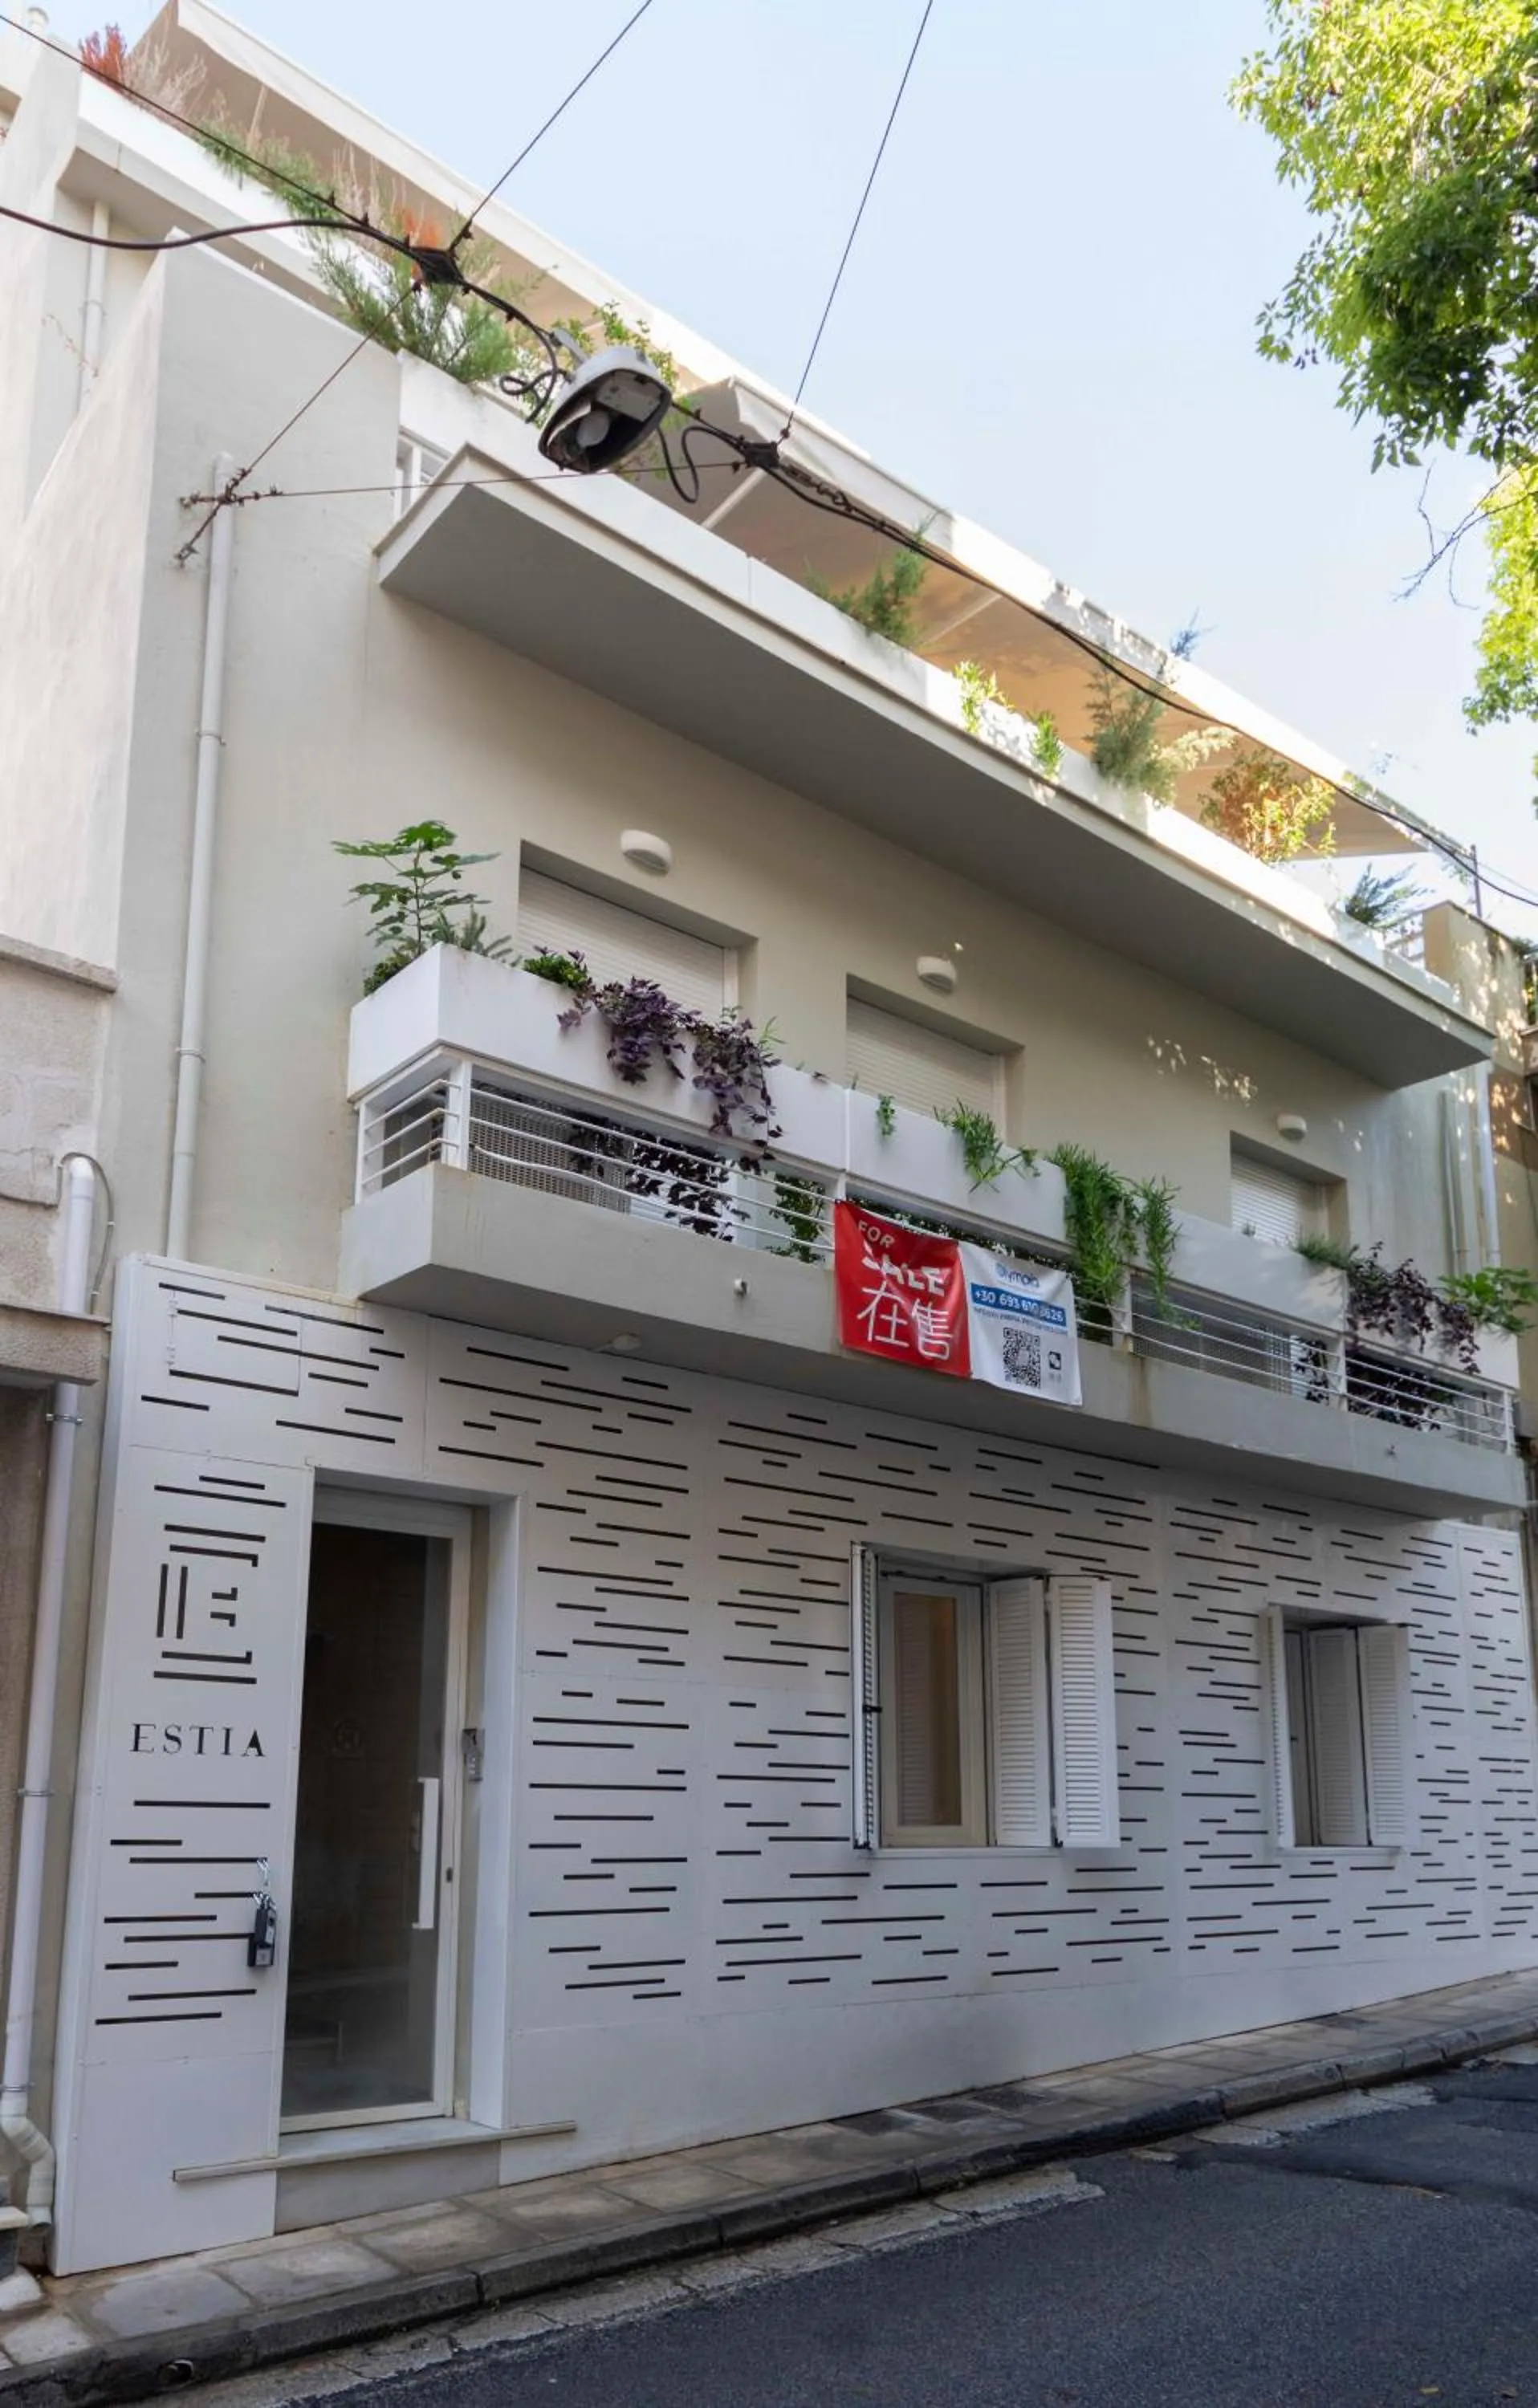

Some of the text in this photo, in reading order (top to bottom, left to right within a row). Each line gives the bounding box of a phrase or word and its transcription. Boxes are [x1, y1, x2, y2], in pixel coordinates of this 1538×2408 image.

[859, 1220, 895, 1248] FOR
[974, 1291, 996, 1304] +30
[856, 1279, 954, 1361] 在售
[129, 1723, 268, 1757] ESTIA
